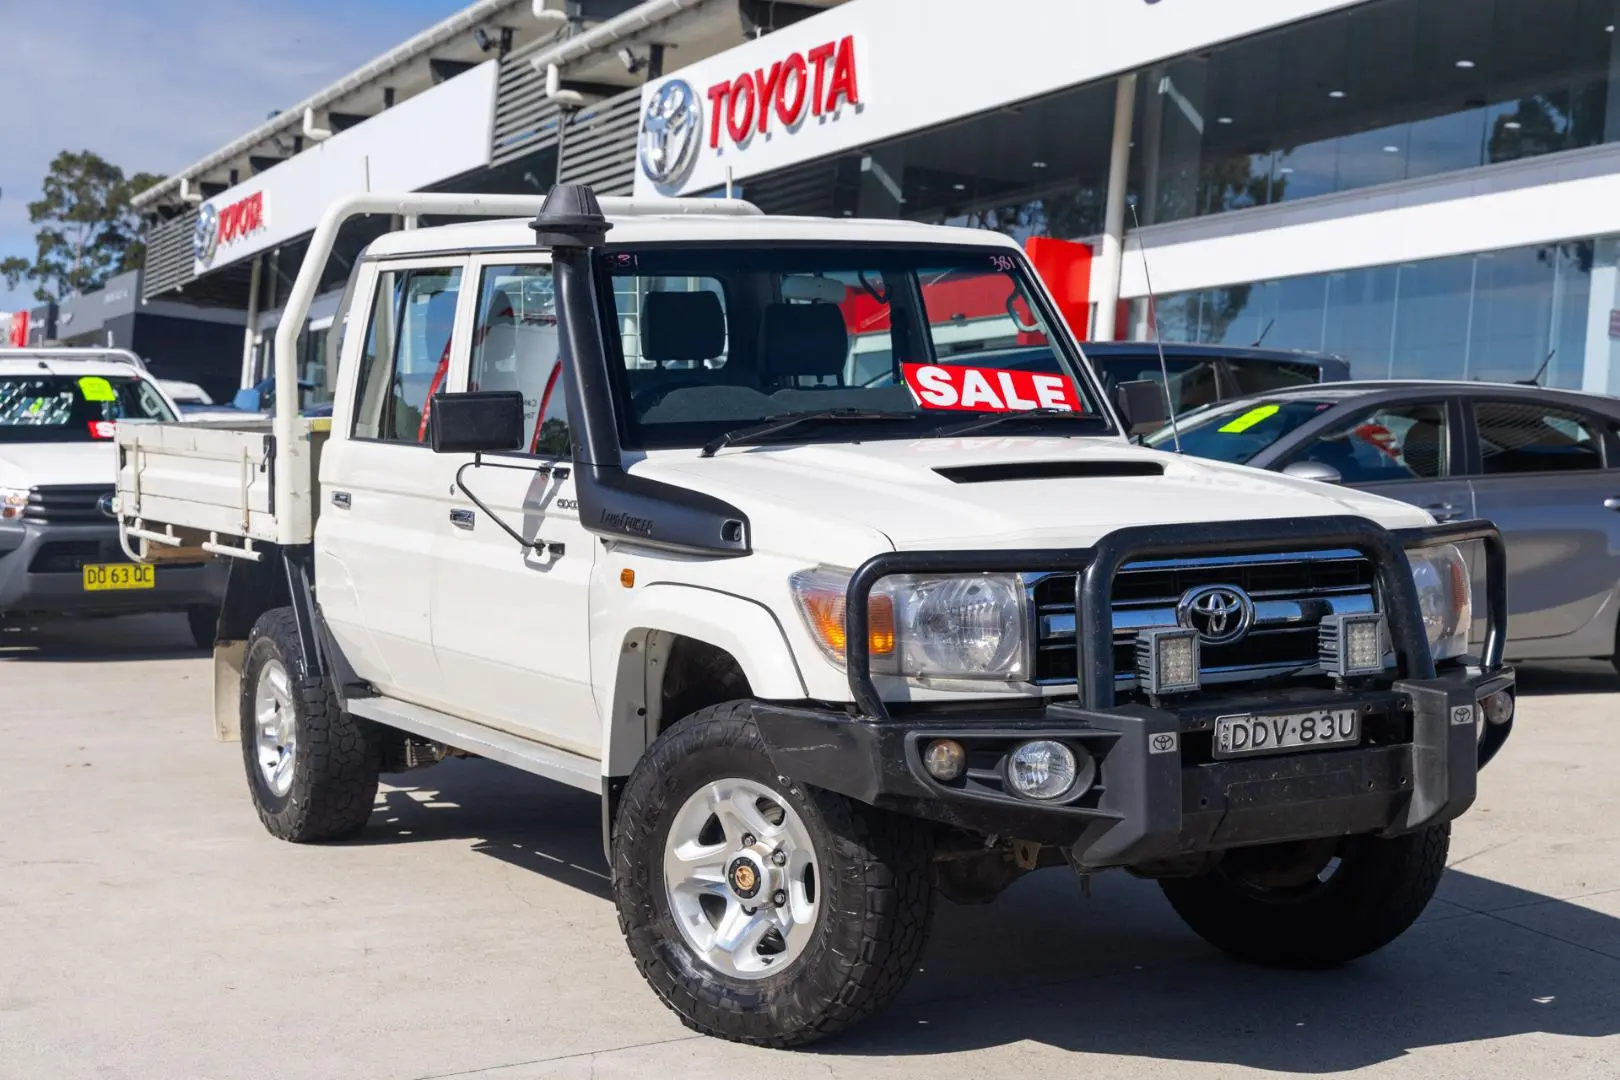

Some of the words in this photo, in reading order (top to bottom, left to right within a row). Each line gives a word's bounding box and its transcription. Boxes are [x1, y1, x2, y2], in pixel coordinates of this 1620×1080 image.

[707, 34, 858, 149] TOYOTA
[217, 190, 262, 244] TOYOTA
[989, 255, 1016, 272] 381
[916, 366, 1072, 412] SALE
